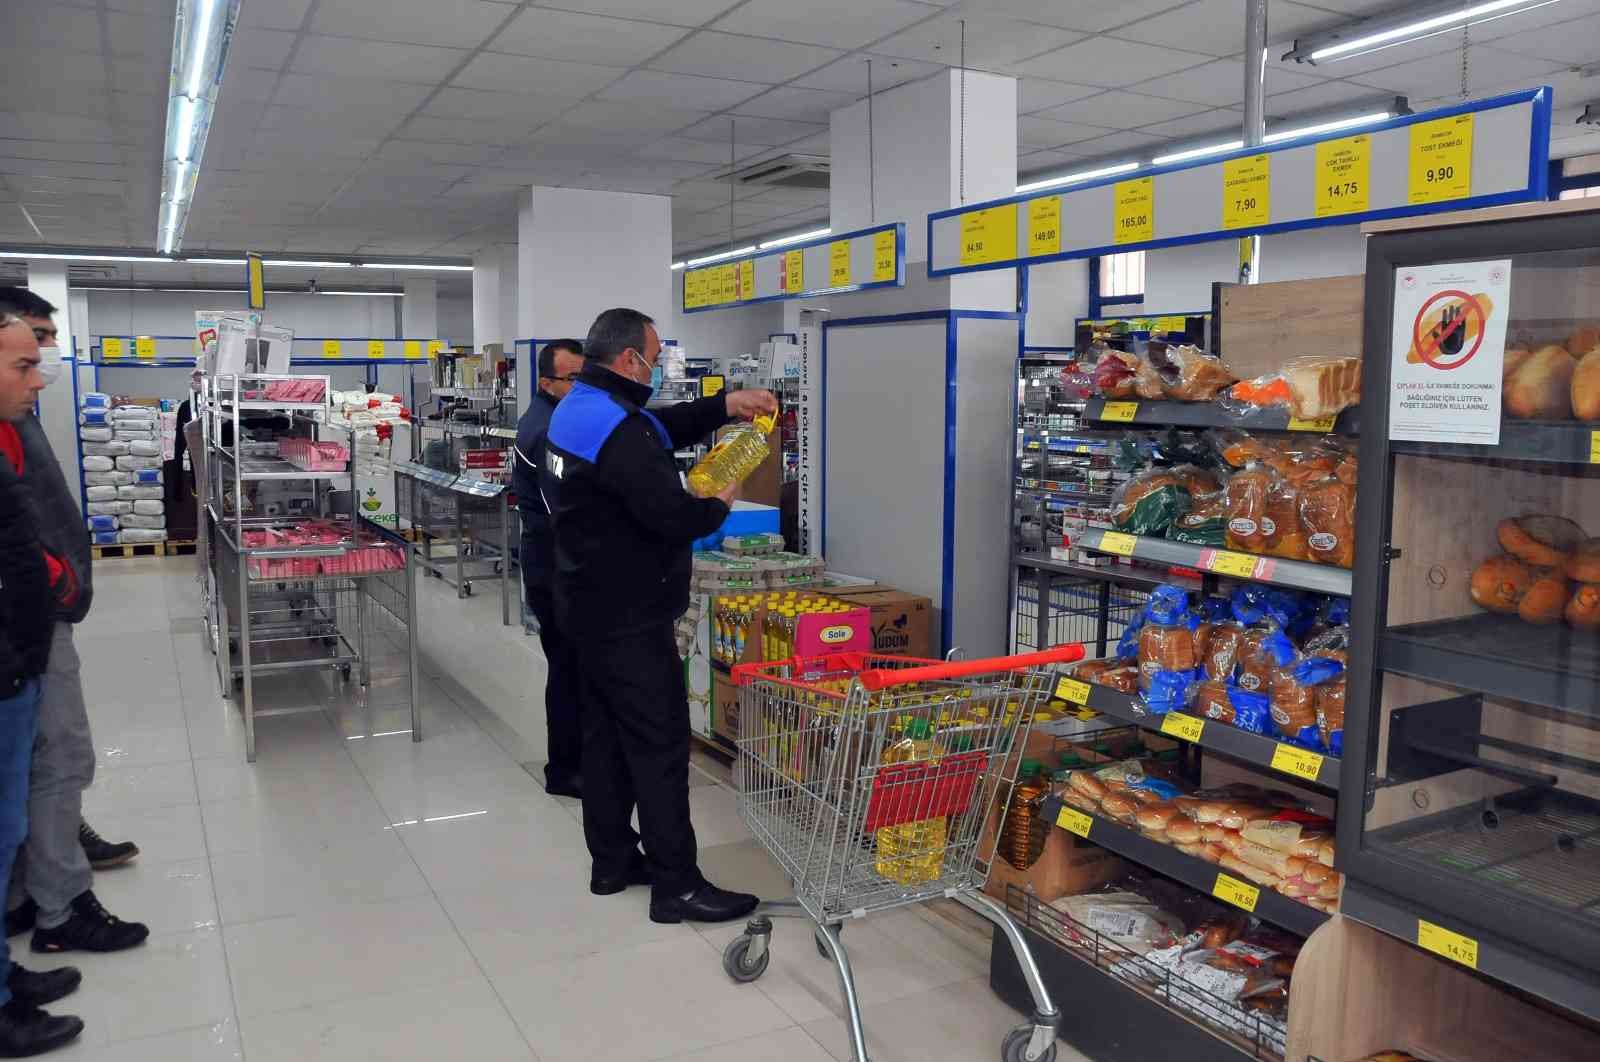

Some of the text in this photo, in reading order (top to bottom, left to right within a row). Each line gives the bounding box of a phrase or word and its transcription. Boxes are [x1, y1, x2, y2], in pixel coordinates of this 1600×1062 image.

[1425, 166, 1454, 183] 9,90
[1327, 182, 1358, 197] 14,75
[1235, 198, 1256, 212] 7,90
[1121, 215, 1147, 229] 165,00
[802, 406, 810, 470] BÖLMELİ
[801, 473, 810, 504] ÇİFT
[1181, 725, 1200, 738] 10,90
[1295, 761, 1317, 776] 10,90
[1233, 892, 1255, 907] 18,50
[1447, 944, 1475, 962] 14,75
